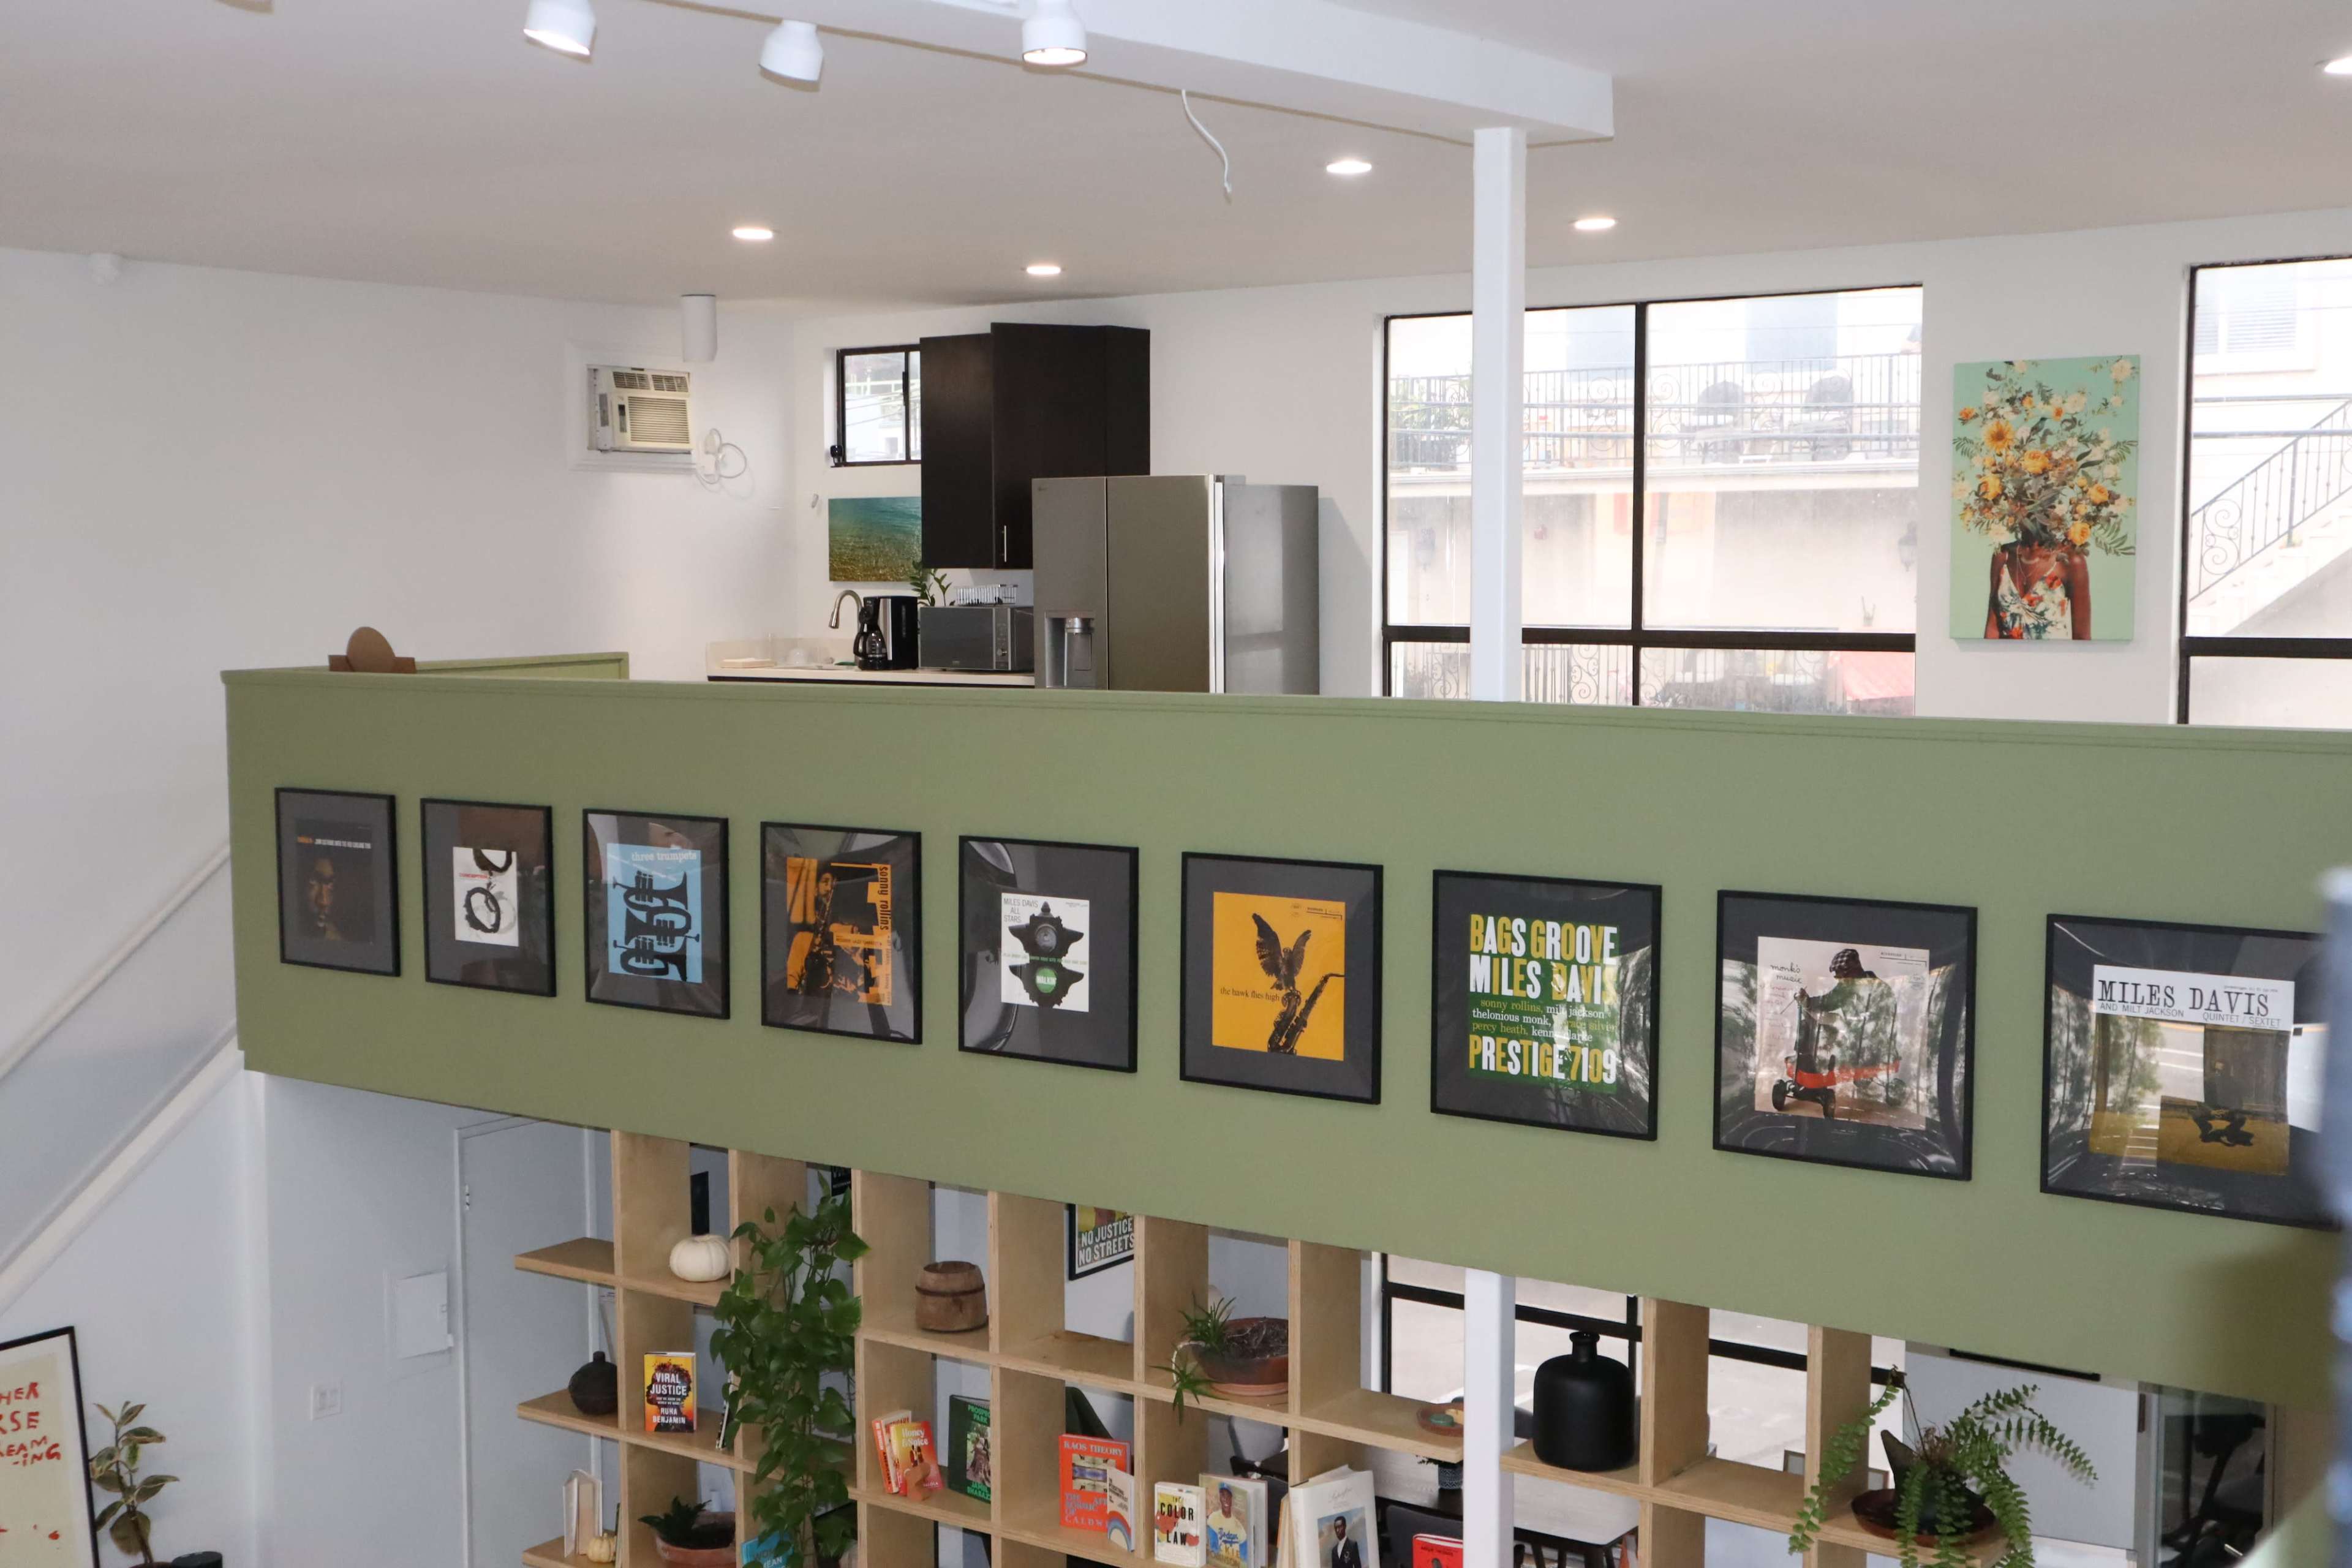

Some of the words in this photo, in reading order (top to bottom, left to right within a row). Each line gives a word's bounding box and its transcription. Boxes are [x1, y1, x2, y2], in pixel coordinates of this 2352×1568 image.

[631, 851, 654, 861] three
[657, 852, 697, 863] trumpets
[878, 867, 888, 895] sonny
[1004, 897, 1020, 907] MILES
[1022, 899, 1039, 908] DAVIS
[880, 900, 891, 930] rollins
[1471, 914, 1526, 957] BAGS
[1531, 920, 1618, 965] GROOVE
[1770, 962, 1801, 973] monk's
[1470, 954, 1541, 1000] MILES
[1551, 962, 1618, 1006] DAVIS
[1776, 974, 1803, 984] music
[1220, 986, 1230, 995] the
[1232, 988, 1249, 998] hawk
[1265, 992, 1280, 1003] high
[2098, 980, 2175, 1008] MILES
[2189, 987, 2269, 1017] DAVIS
[1480, 999, 1508, 1011] sonny
[1511, 1001, 1543, 1014] rollins,
[1547, 1005, 1567, 1016] milt
[2100, 1003, 2117, 1011] AND
[2122, 1005, 2142, 1014] MILT
[2144, 1007, 2184, 1017] JACKSON
[2203, 1011, 2239, 1023] QUINTET
[2248, 1016, 2282, 1027] SEXTET
[1472, 1009, 1520, 1022] thelonious
[1523, 1016, 1551, 1027] monk,
[1472, 1022, 1497, 1035] percy
[1532, 1027, 1560, 1039] kenn
[1561, 1030, 1593, 1042] larke
[1469, 1035, 1566, 1080] PRESTIGE
[1569, 1045, 1618, 1084] 7109
[1082, 1230, 1094, 1247] NO
[1095, 1217, 1133, 1242] JUSTICE
[1079, 1247, 1091, 1266] NO
[1093, 1233, 1134, 1260] STREETS
[655, 1373, 680, 1383] VIRAL
[650, 1385, 687, 1395] JUSTICE
[653, 1415, 685, 1424] BENJAMIN
[974, 1413, 987, 1424] PARK
[902, 1428, 925, 1438] Honey
[1064, 1441, 1087, 1450] KAOS
[1090, 1444, 1123, 1456] THEORY
[1161, 1502, 1194, 1521] COLOR
[1167, 1531, 1187, 1545] LAW
